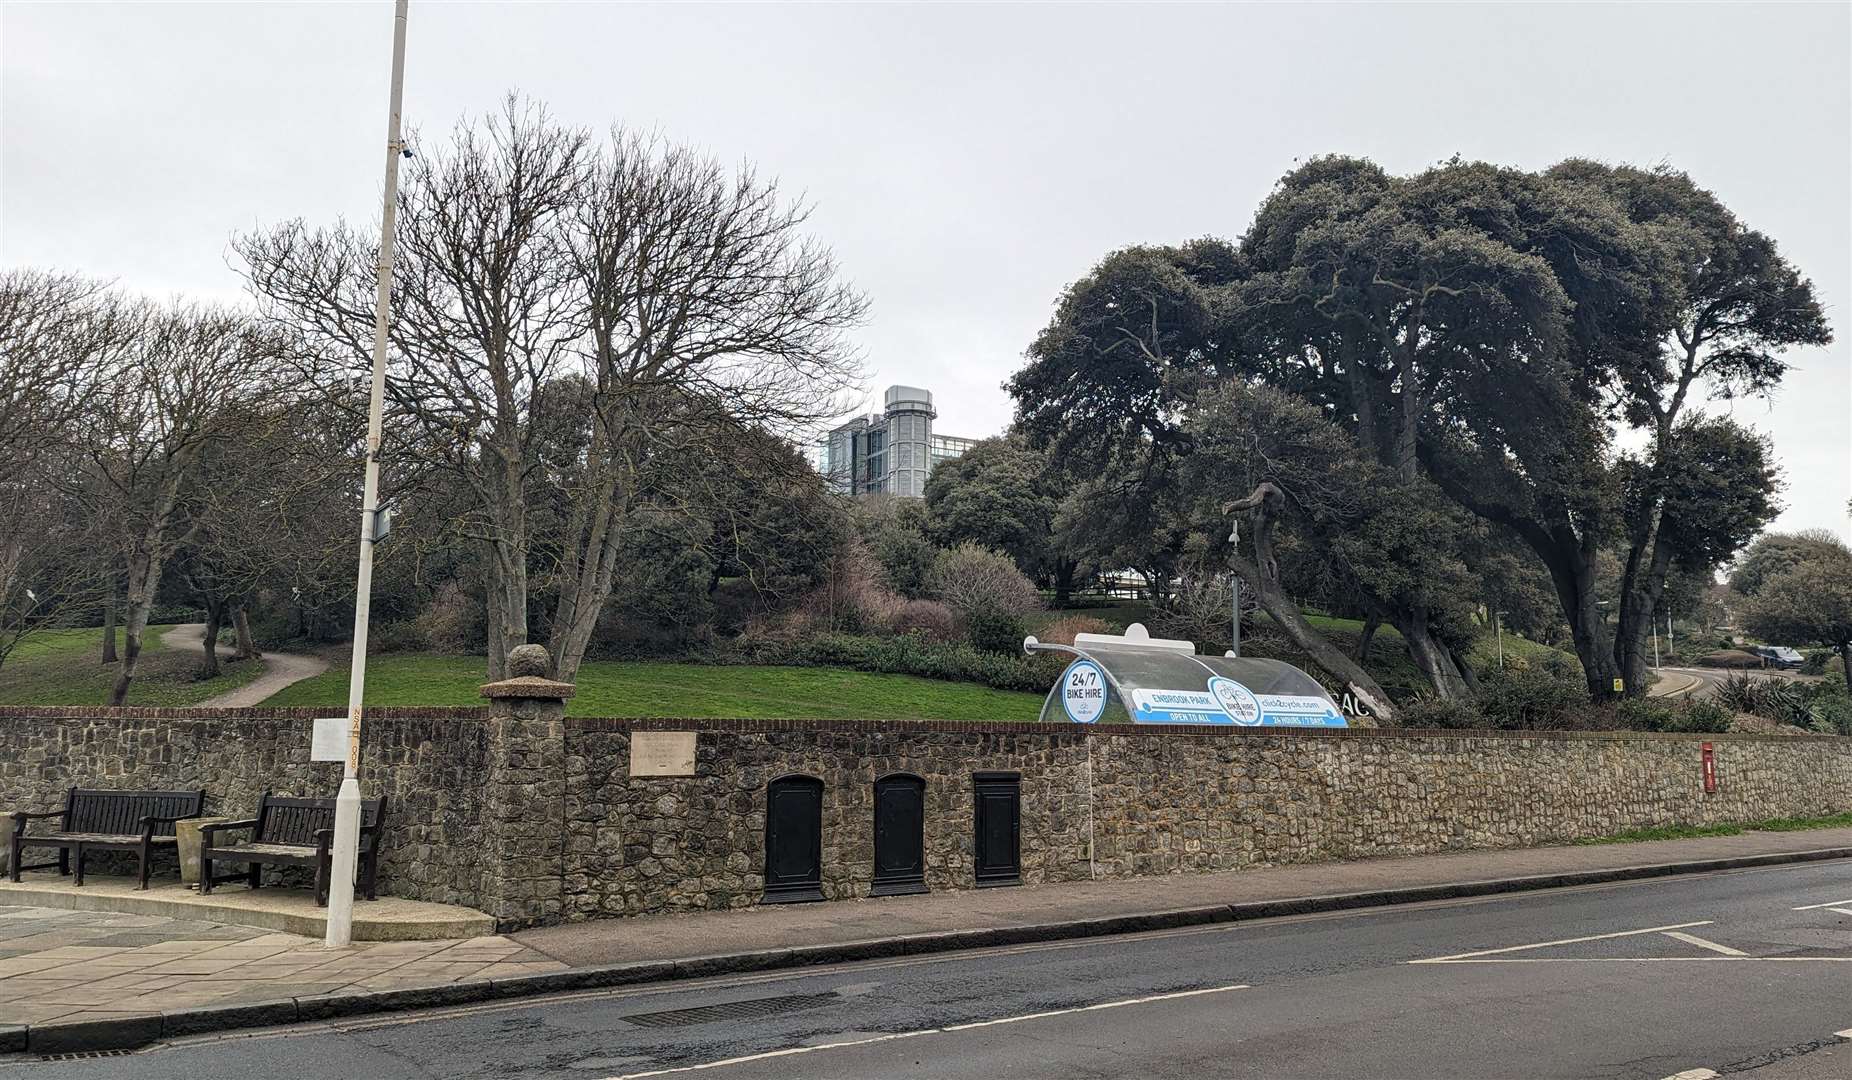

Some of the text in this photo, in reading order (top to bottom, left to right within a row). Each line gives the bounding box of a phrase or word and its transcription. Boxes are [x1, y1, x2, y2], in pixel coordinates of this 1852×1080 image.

[1072, 673, 1096, 686] 24/7
[1067, 688, 1102, 699] BIKE HIRE
[1152, 694, 1211, 705] ENBROOK PARK
[1226, 702, 1240, 710] BIKE
[1170, 713, 1211, 722] OPEN TO ALL
